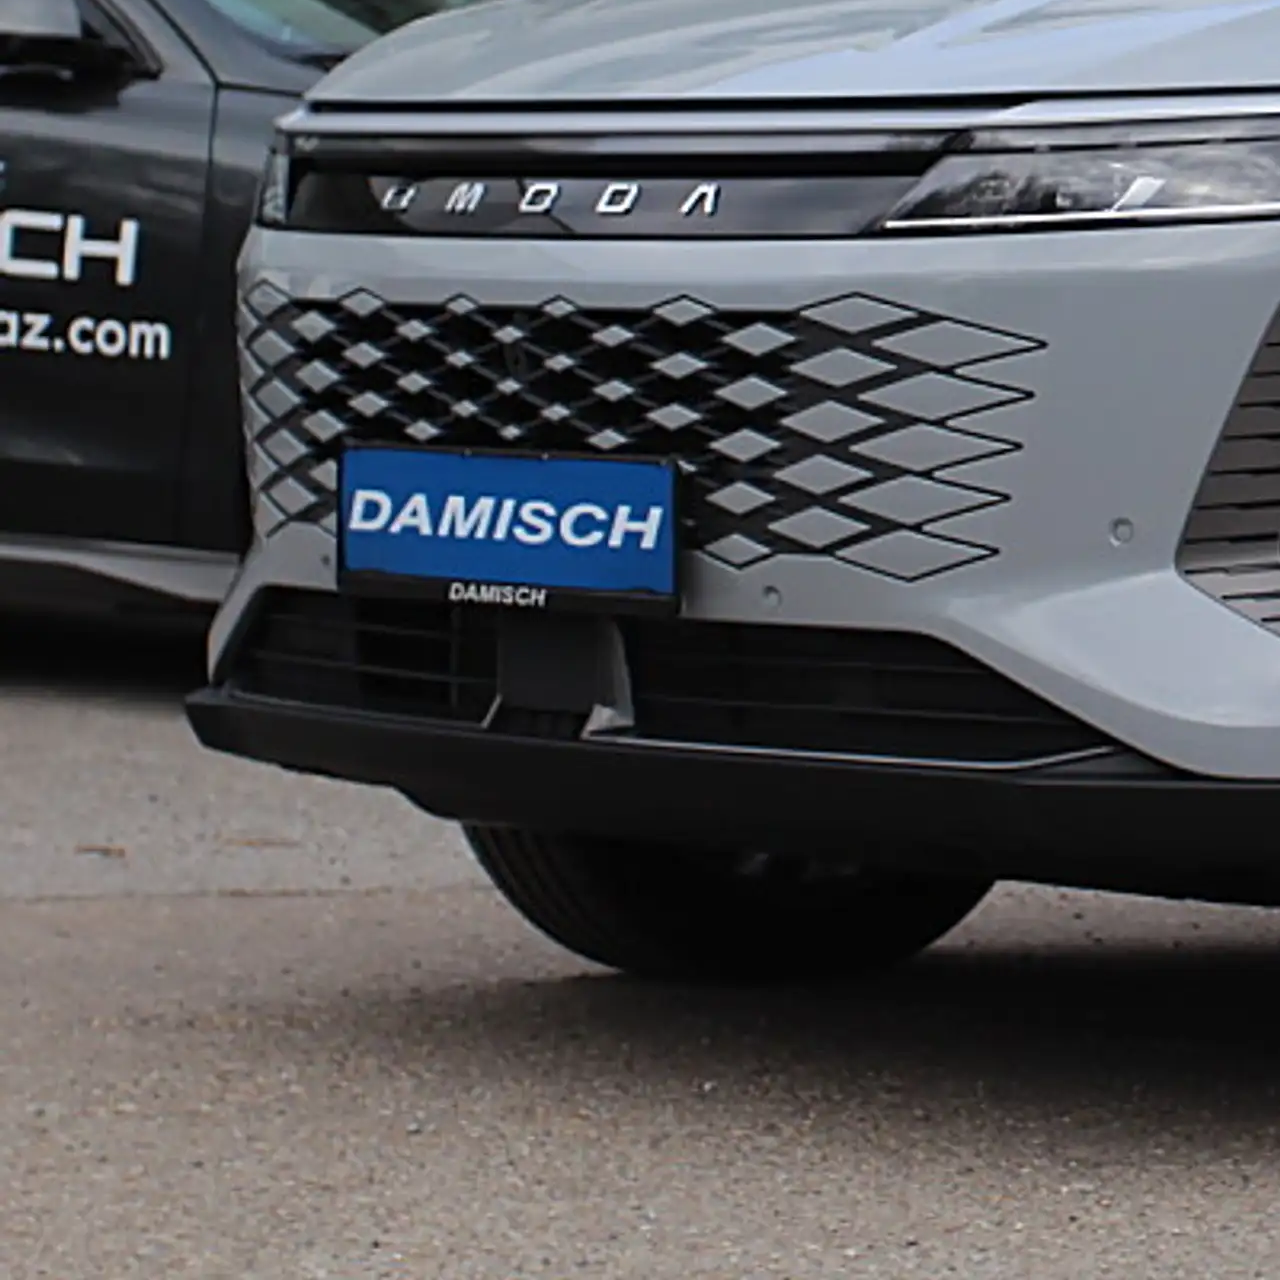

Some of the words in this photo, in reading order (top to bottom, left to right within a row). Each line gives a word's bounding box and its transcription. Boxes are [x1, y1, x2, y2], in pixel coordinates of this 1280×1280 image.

[380, 181, 721, 216] OMODA
[0, 209, 139, 286] CH
[348, 488, 664, 551] DAMISCH
[447, 581, 549, 608] DAMISCH
